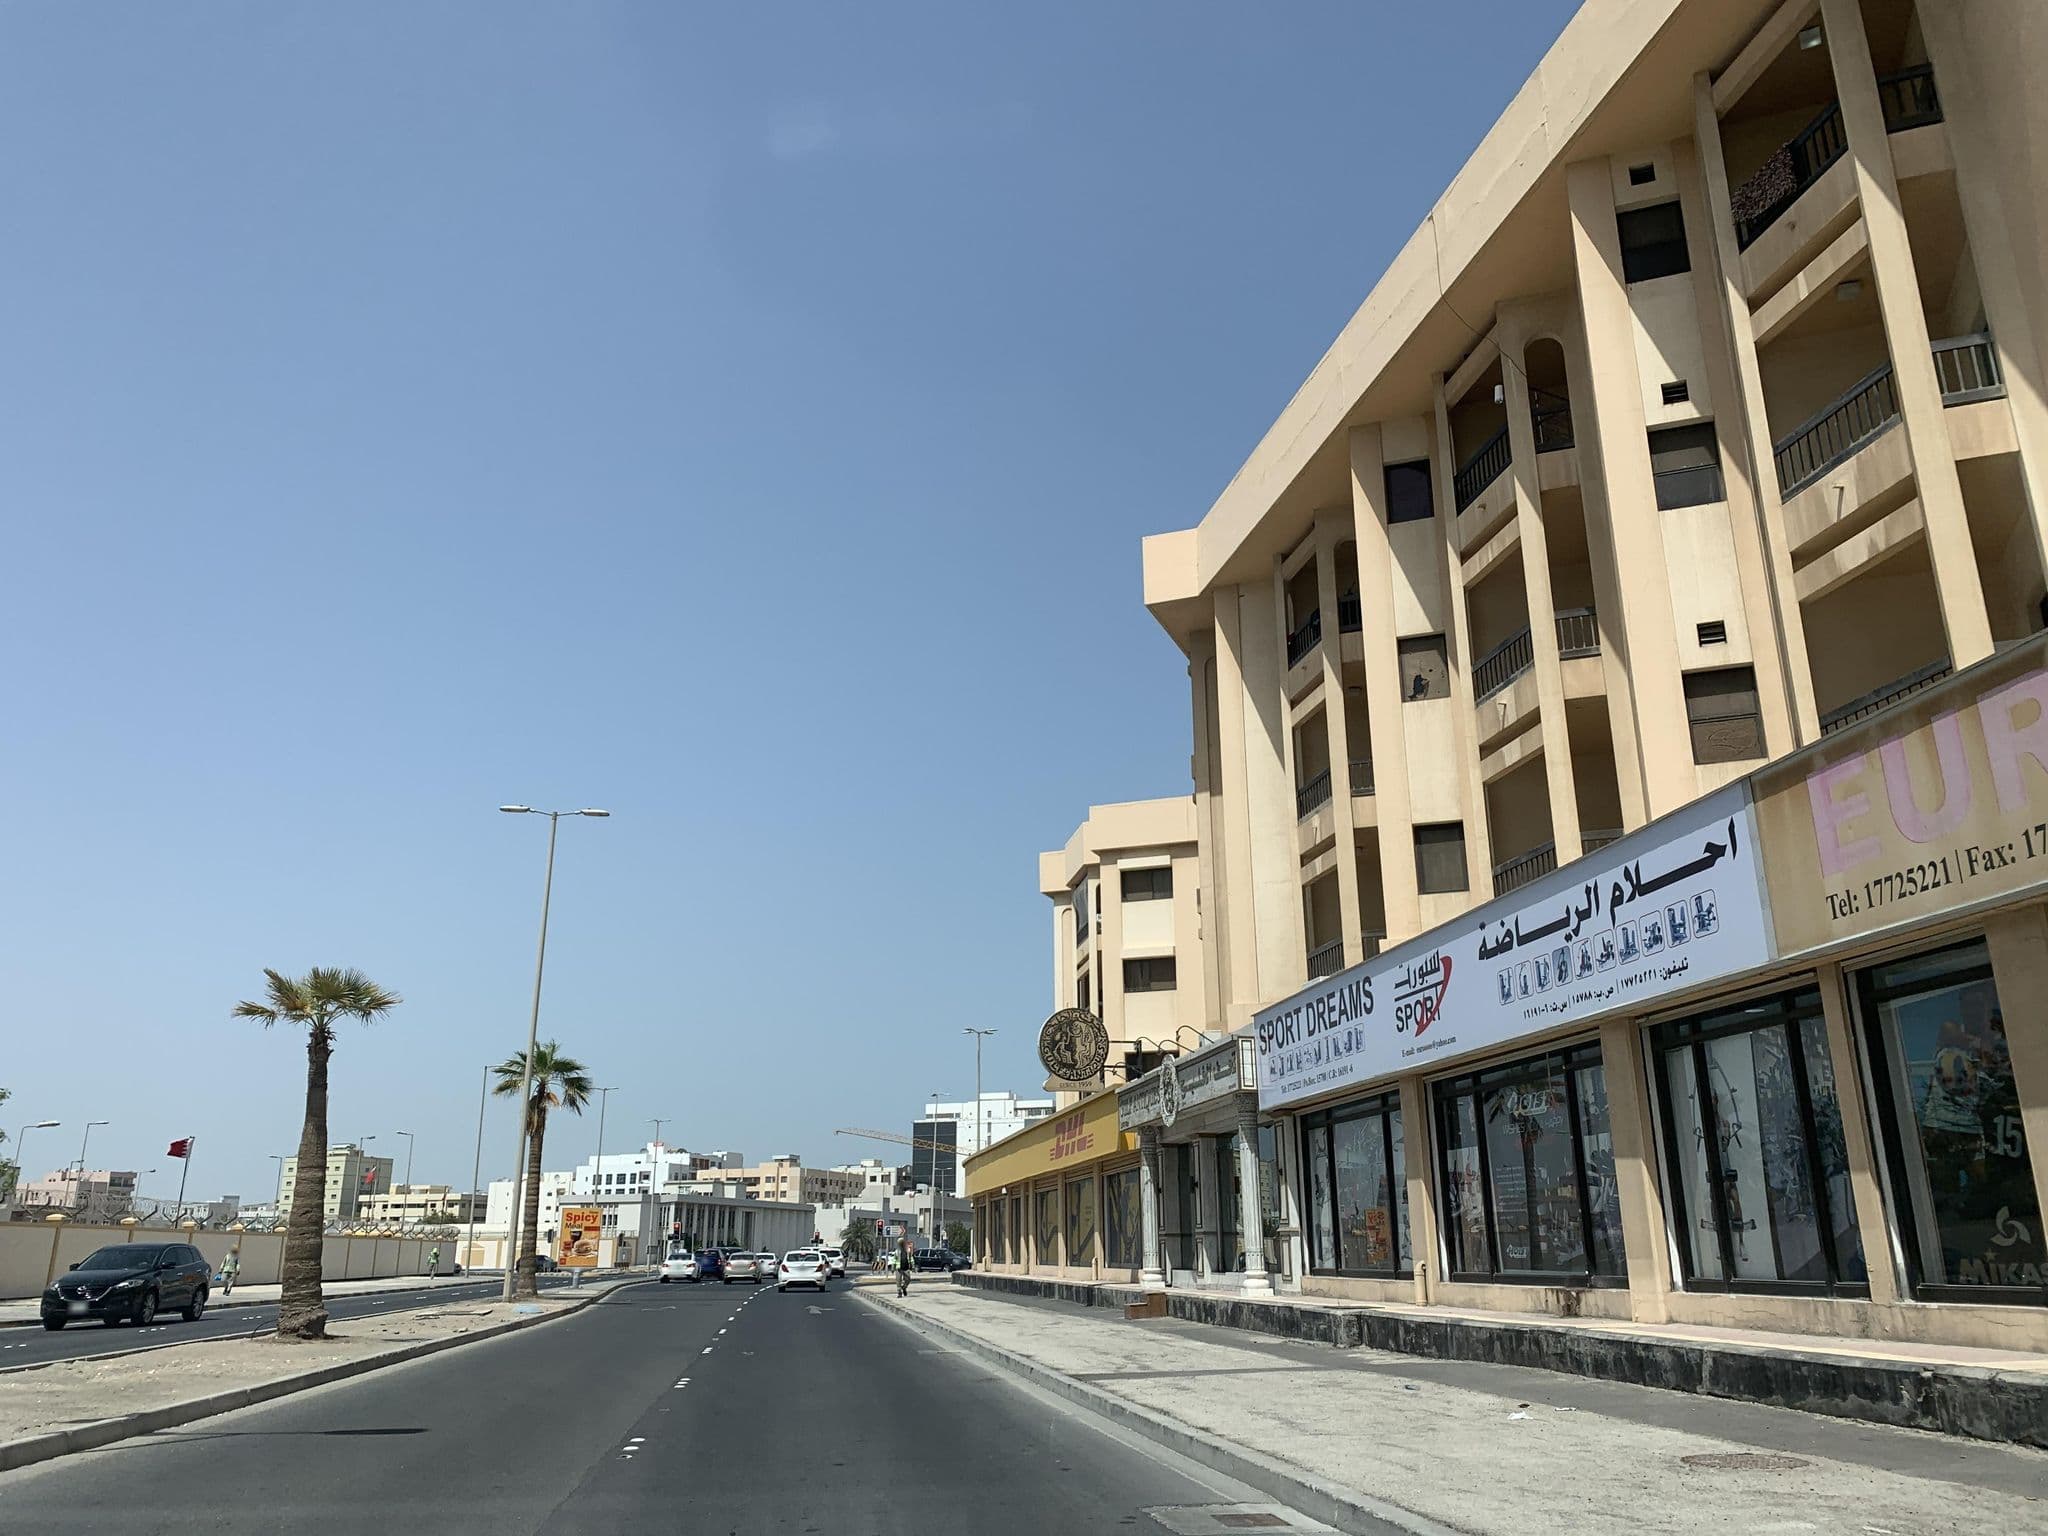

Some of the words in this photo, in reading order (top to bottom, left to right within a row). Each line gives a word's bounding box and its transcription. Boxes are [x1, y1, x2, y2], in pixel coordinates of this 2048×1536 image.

[1826, 888, 1860, 921] Tel:
[1863, 857, 1953, 910] 17725221
[1965, 842, 2017, 878] Fax:
[1478, 878, 1600, 961] الرياضة
[1259, 1006, 1302, 1056] SPORT
[1305, 975, 1375, 1038] DREAMS
[1395, 985, 1441, 1033] SPORT
[1992, 1114, 2023, 1159] 15
[566, 1212, 599, 1225] Spicy
